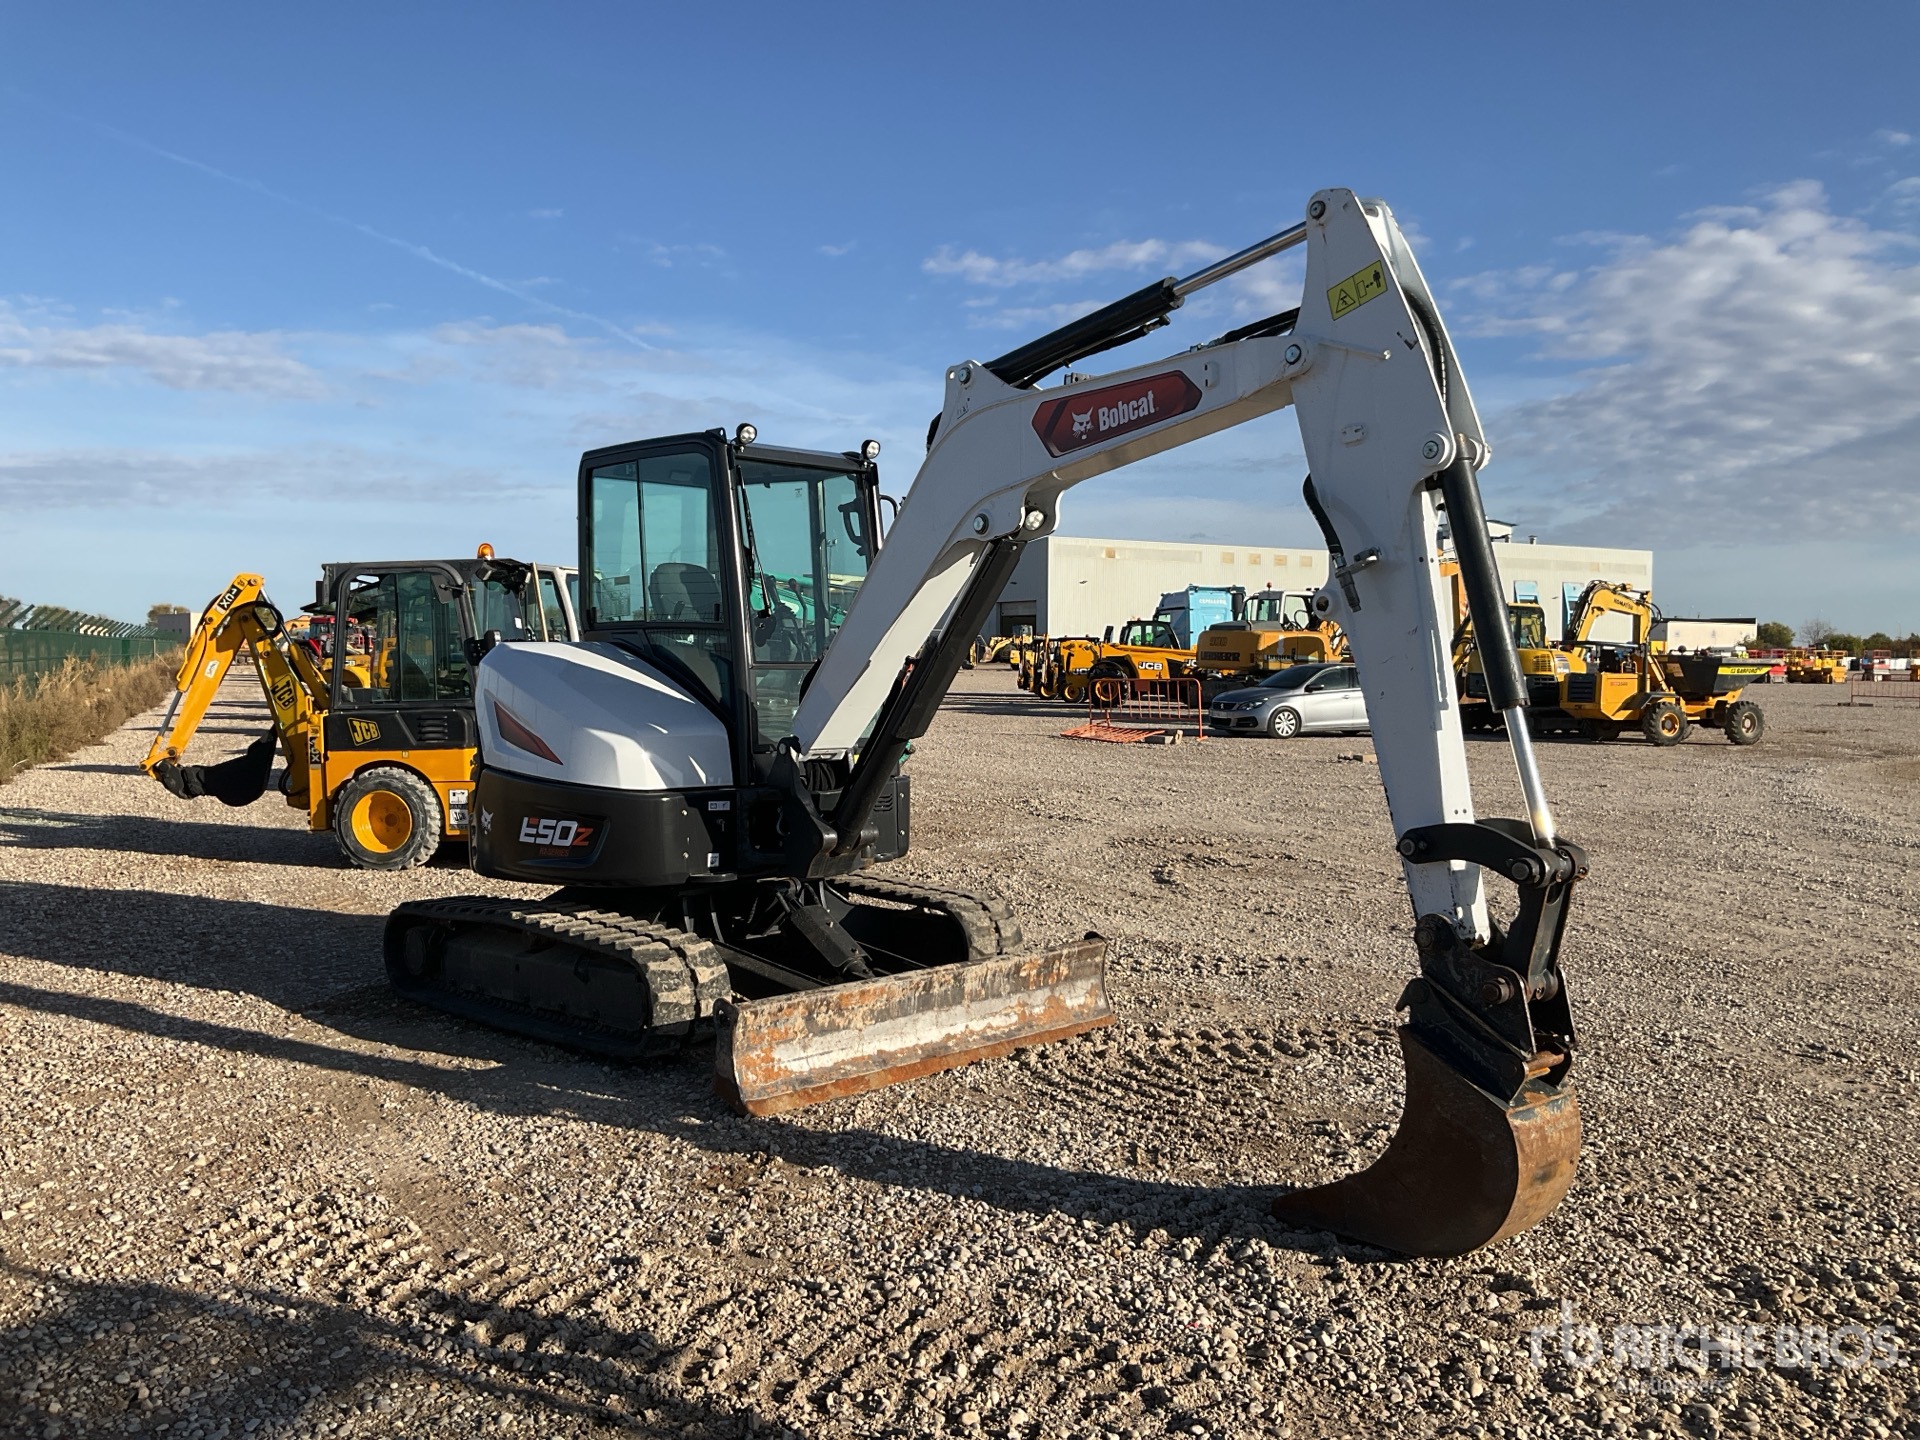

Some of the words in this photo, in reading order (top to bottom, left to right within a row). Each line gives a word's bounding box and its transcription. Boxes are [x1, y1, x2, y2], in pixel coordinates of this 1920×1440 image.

[1098, 390, 1155, 432] Bobcat
[1138, 661, 1163, 671] JCB
[271, 680, 296, 708] JCB
[352, 720, 379, 743] JCB
